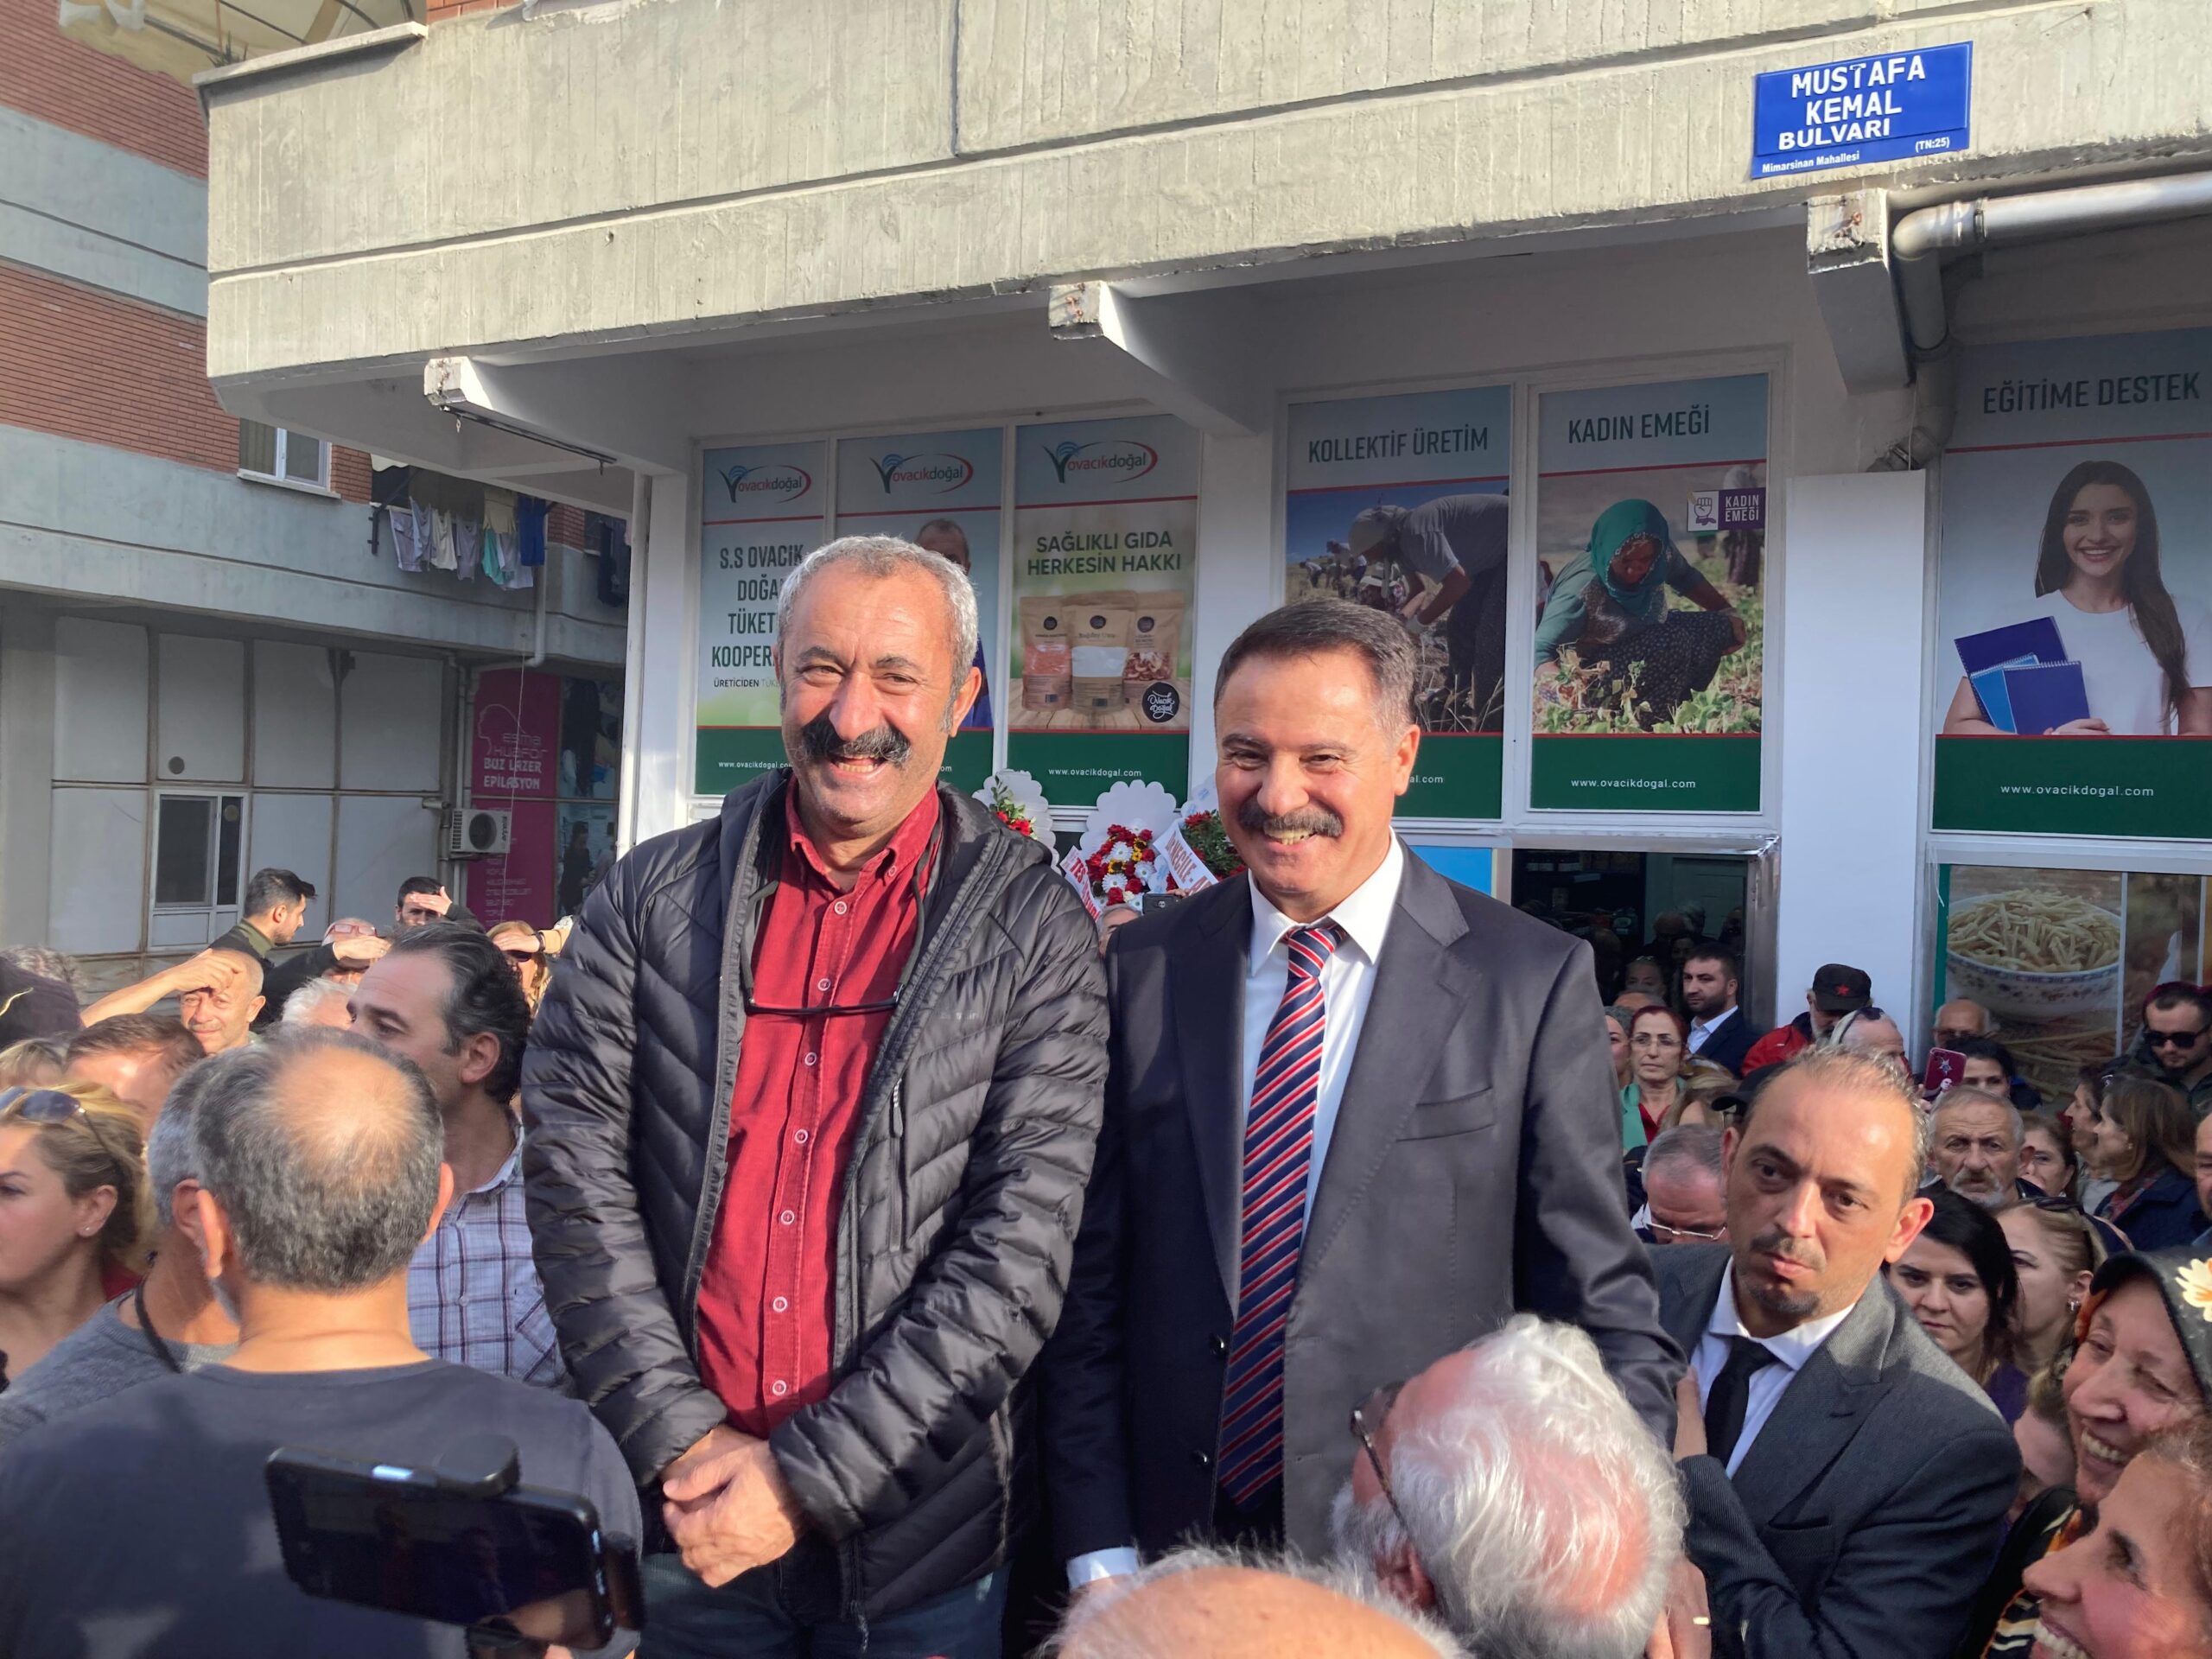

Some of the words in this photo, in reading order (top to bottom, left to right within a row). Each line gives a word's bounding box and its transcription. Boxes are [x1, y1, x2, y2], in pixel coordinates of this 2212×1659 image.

[1791, 55, 1925, 98] MUSTAFA
[1806, 90, 1902, 125] KEMAL
[1778, 118, 1890, 150] BULVARI
[1915, 137, 1950, 153] (TN:25)
[1762, 159, 1814, 173] Mimarsinan
[1816, 151, 1859, 166] Mahallesi
[1983, 378, 2089, 415] EĞİTİME
[2098, 372, 2200, 406] DESTEK
[1568, 415, 1633, 444] KADIN
[1642, 404, 1709, 438] EMEĞİ
[1308, 429, 1406, 463] KOLLEKTİF
[1413, 423, 1488, 455] ÜRETİM
[1725, 494, 1759, 508] KADIN
[1037, 531, 1118, 553] SAĞLIKLI
[1124, 531, 1173, 550] GIDA
[720, 547, 743, 569] S.S
[1027, 552, 1116, 575] HERKESİN
[1122, 554, 1181, 572] HAKKI
[737, 574, 783, 601] DOĞA
[728, 608, 776, 634] TÜKET
[712, 645, 777, 667] KOOPER
[714, 677, 760, 688] ÜRETİCİDEN
[1048, 768, 1141, 778] www.ovacikdogal.com
[1571, 779, 1696, 790] www.ovacikdogal.com
[2000, 785, 2154, 797] www.ovacikdogal.com
